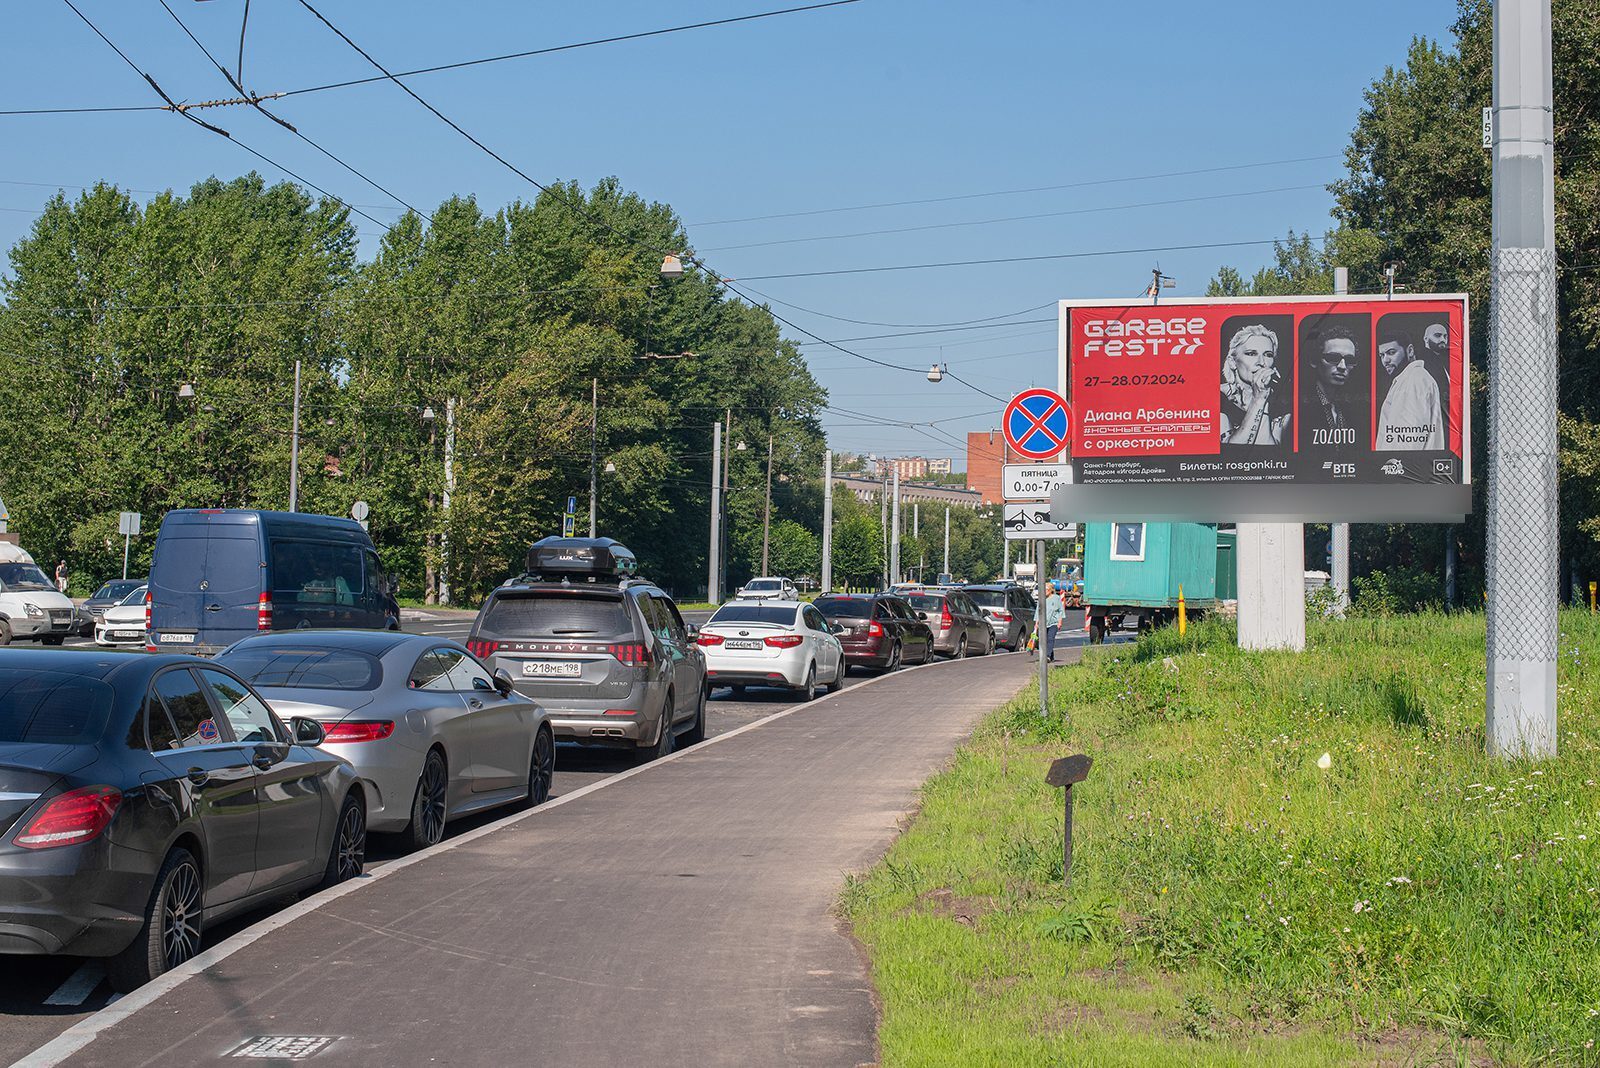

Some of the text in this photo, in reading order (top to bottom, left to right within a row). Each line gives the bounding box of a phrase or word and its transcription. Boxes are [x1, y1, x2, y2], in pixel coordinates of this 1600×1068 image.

[1084, 408, 1210, 422] Диана Арбенина
[1084, 425, 1141, 434] #НОЧНЫЕ
[1386, 424, 1436, 434] HammAli
[1385, 434, 1394, 443] &
[1084, 438, 1175, 451] с оркестром
[1180, 460, 1287, 471] Билеты: rosgonki.ru
[1333, 463, 1356, 474] ВТБ
[1435, 463, 1450, 472] 0+
[1014, 481, 1066, 492] 0.00-7.0
[526, 663, 579, 673] С218МЕ 198
